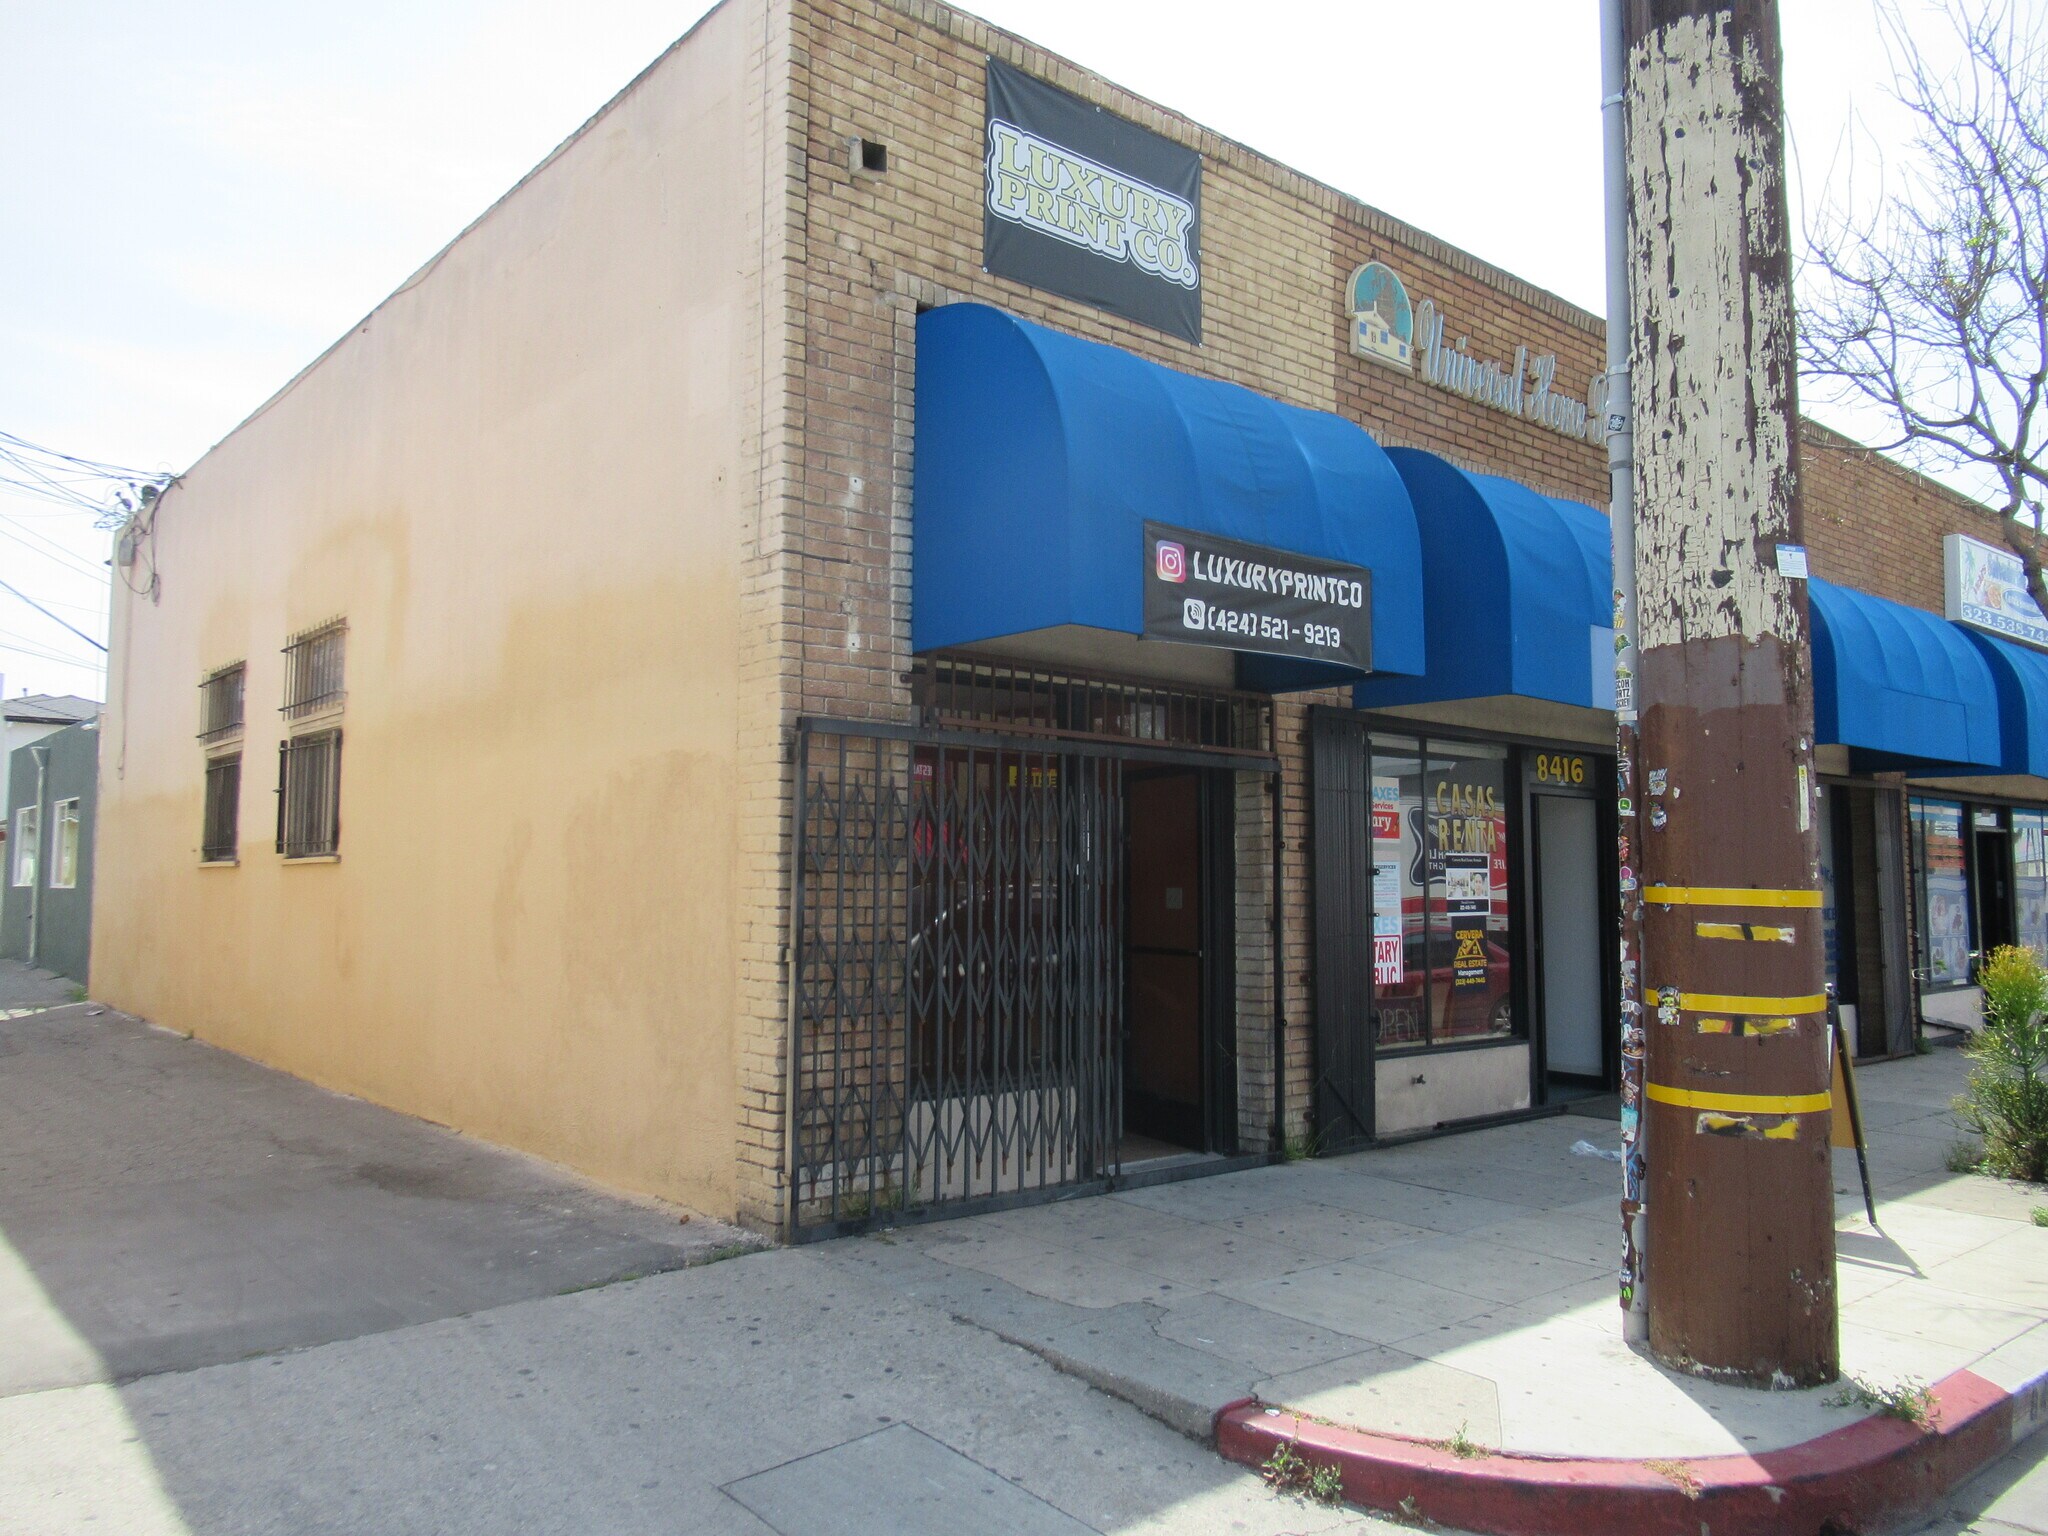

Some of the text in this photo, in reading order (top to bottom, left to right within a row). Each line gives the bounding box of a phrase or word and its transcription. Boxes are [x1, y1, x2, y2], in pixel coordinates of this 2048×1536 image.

[998, 131, 1187, 242] LUXURY
[997, 171, 1194, 279] PRINT CO.
[1192, 550, 1363, 609] LUXURYPRINTCO
[1207, 606, 1258, 637] (424)
[1304, 622, 1341, 648] 9213
[1536, 754, 1584, 784] 8416
[1372, 786, 1399, 801] AXES
[1436, 781, 1496, 818] CASAS
[1373, 815, 1391, 832] ary
[1438, 818, 1497, 853] RENTA
[1373, 941, 1398, 963] TARY
[1453, 959, 1488, 969] REAL ESTATE
[1373, 966, 1398, 984] BLIC
[1457, 969, 1484, 977] Management
